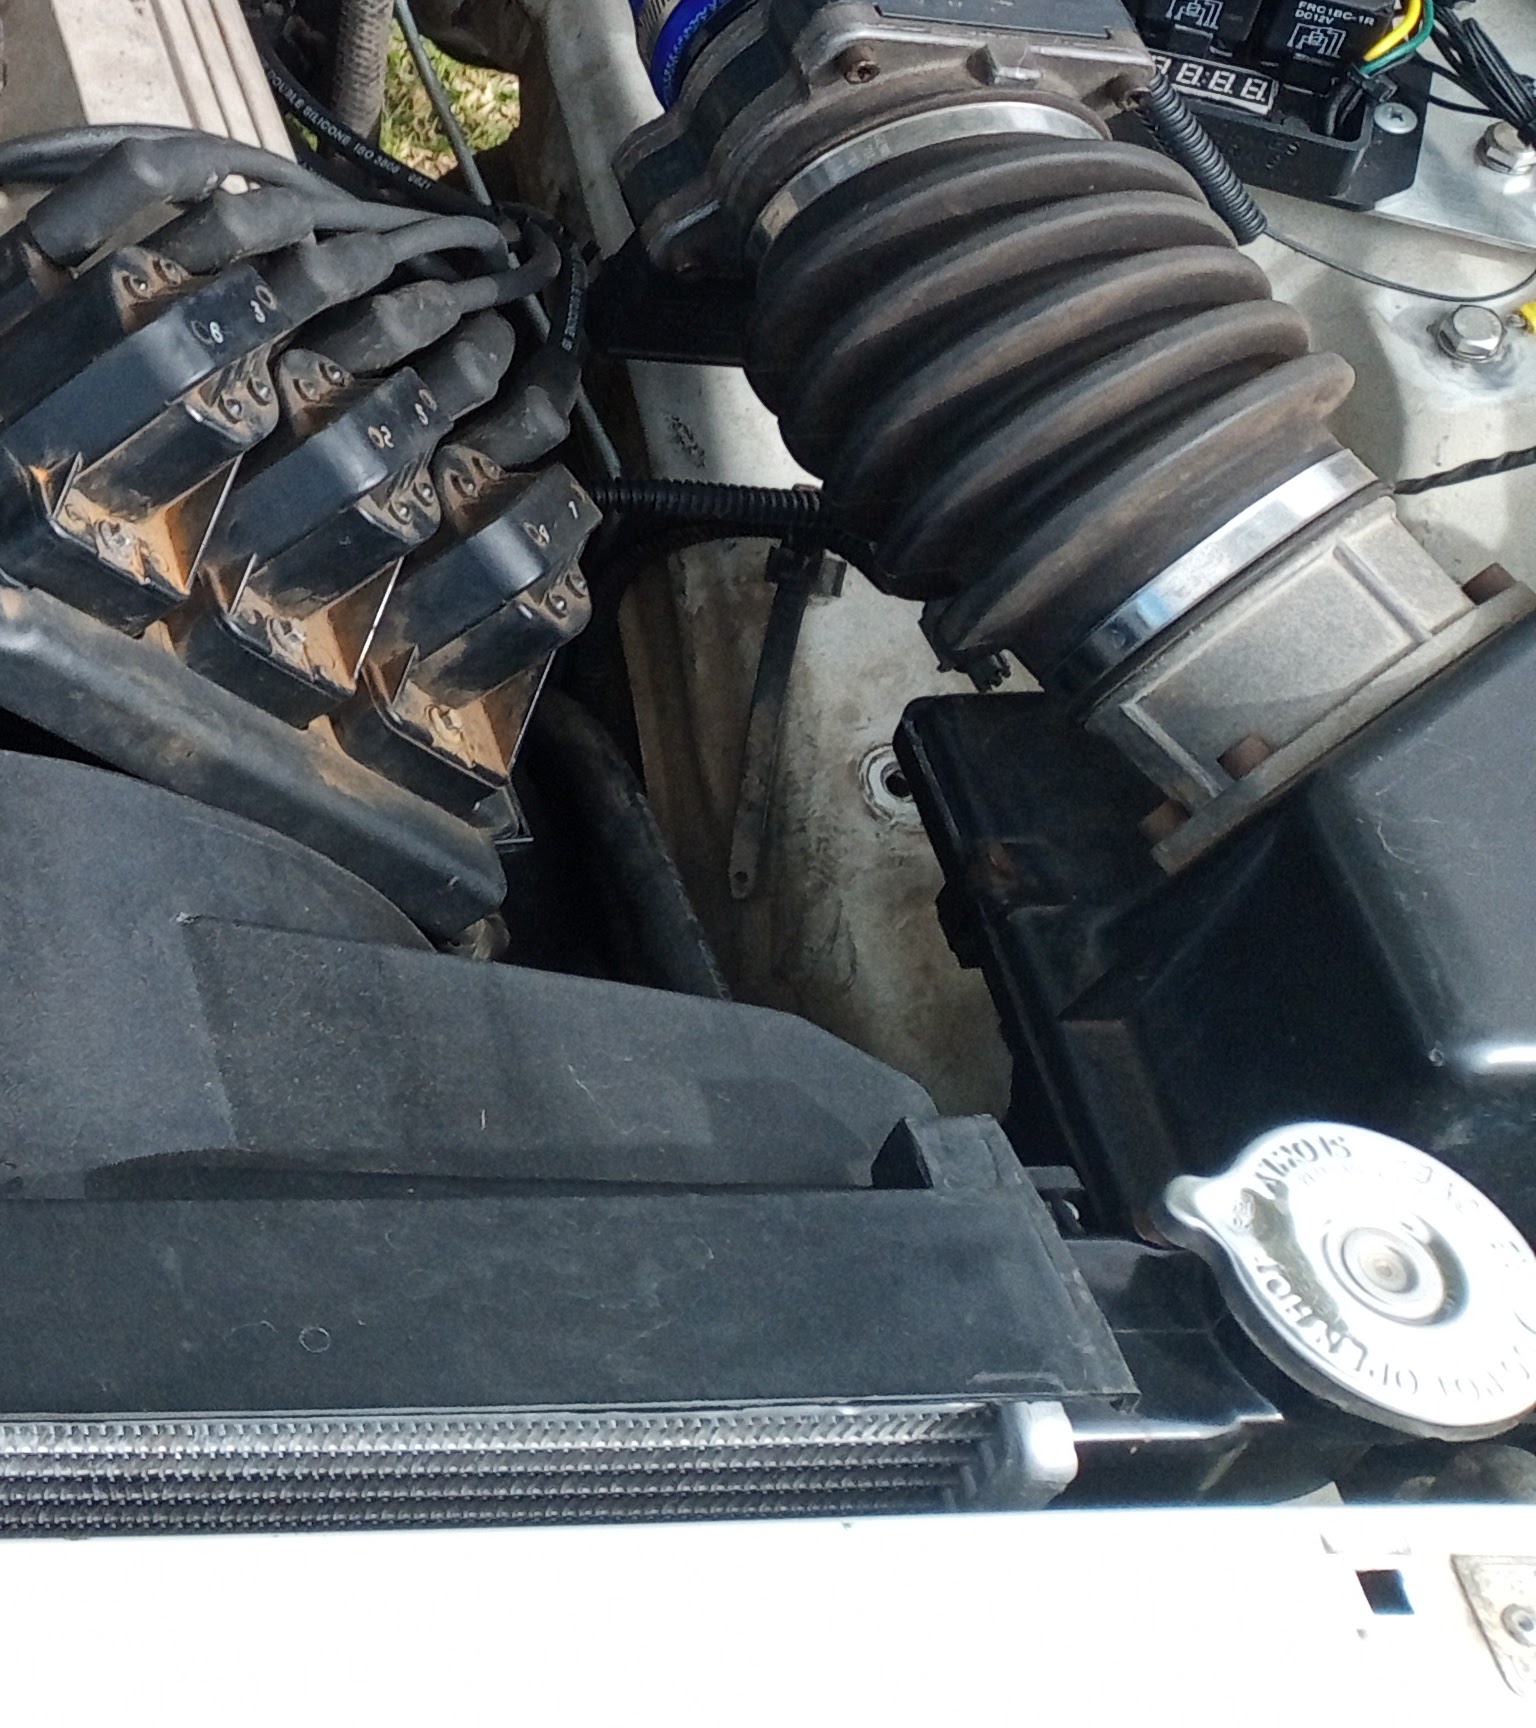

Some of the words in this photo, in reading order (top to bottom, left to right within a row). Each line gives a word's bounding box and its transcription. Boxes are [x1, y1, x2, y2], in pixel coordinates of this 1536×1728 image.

[1295, 9, 1334, 24] DC12V
[1298, 1, 1375, 26] FRC1BC-1R
[302, 105, 352, 147] SILICONE
[353, 143, 375, 160] ISO
